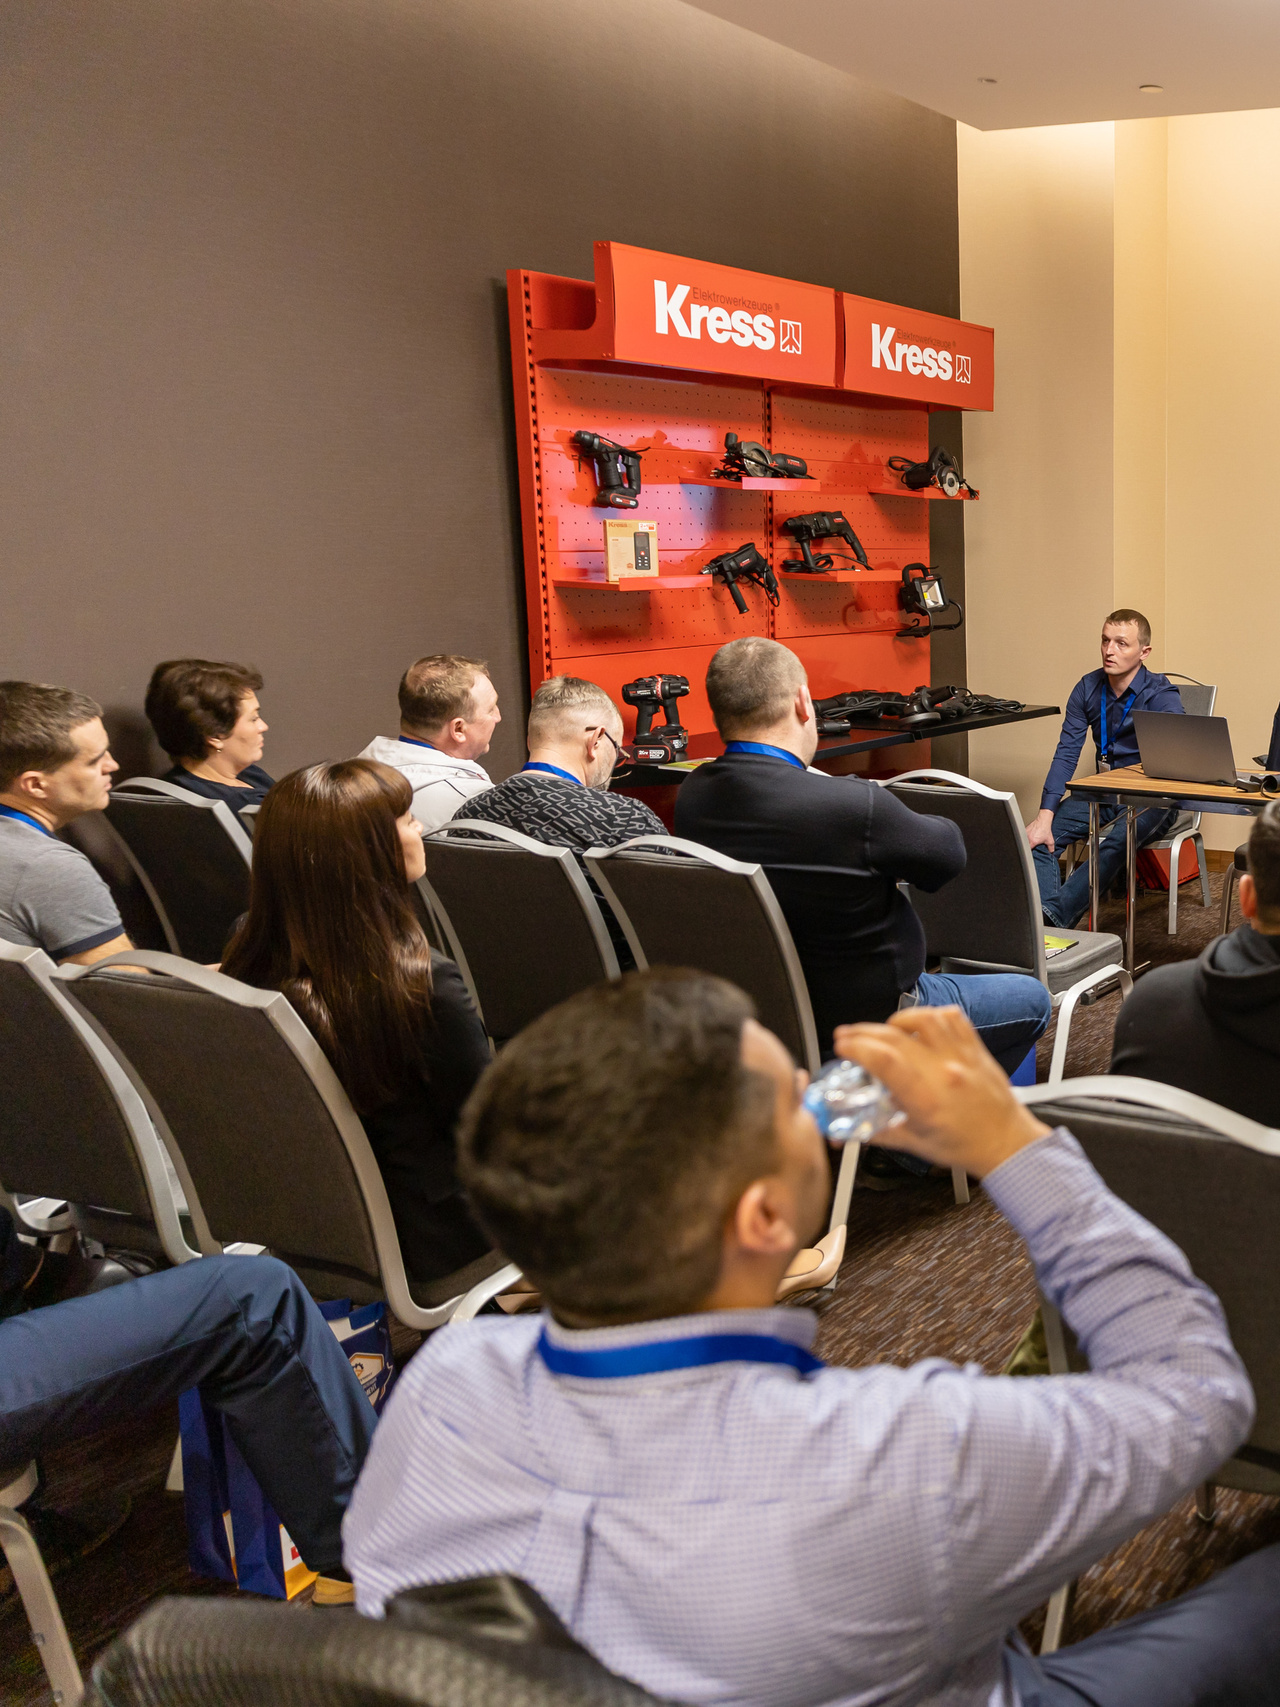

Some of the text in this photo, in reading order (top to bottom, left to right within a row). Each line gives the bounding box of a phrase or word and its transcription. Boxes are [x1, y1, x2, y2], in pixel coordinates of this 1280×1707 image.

[653, 279, 776, 350] Kress
[692, 287, 773, 312] Elektrowerkzeuge
[871, 322, 953, 381] Kress
[896, 328, 952, 349] Elektrowerkzeuge
